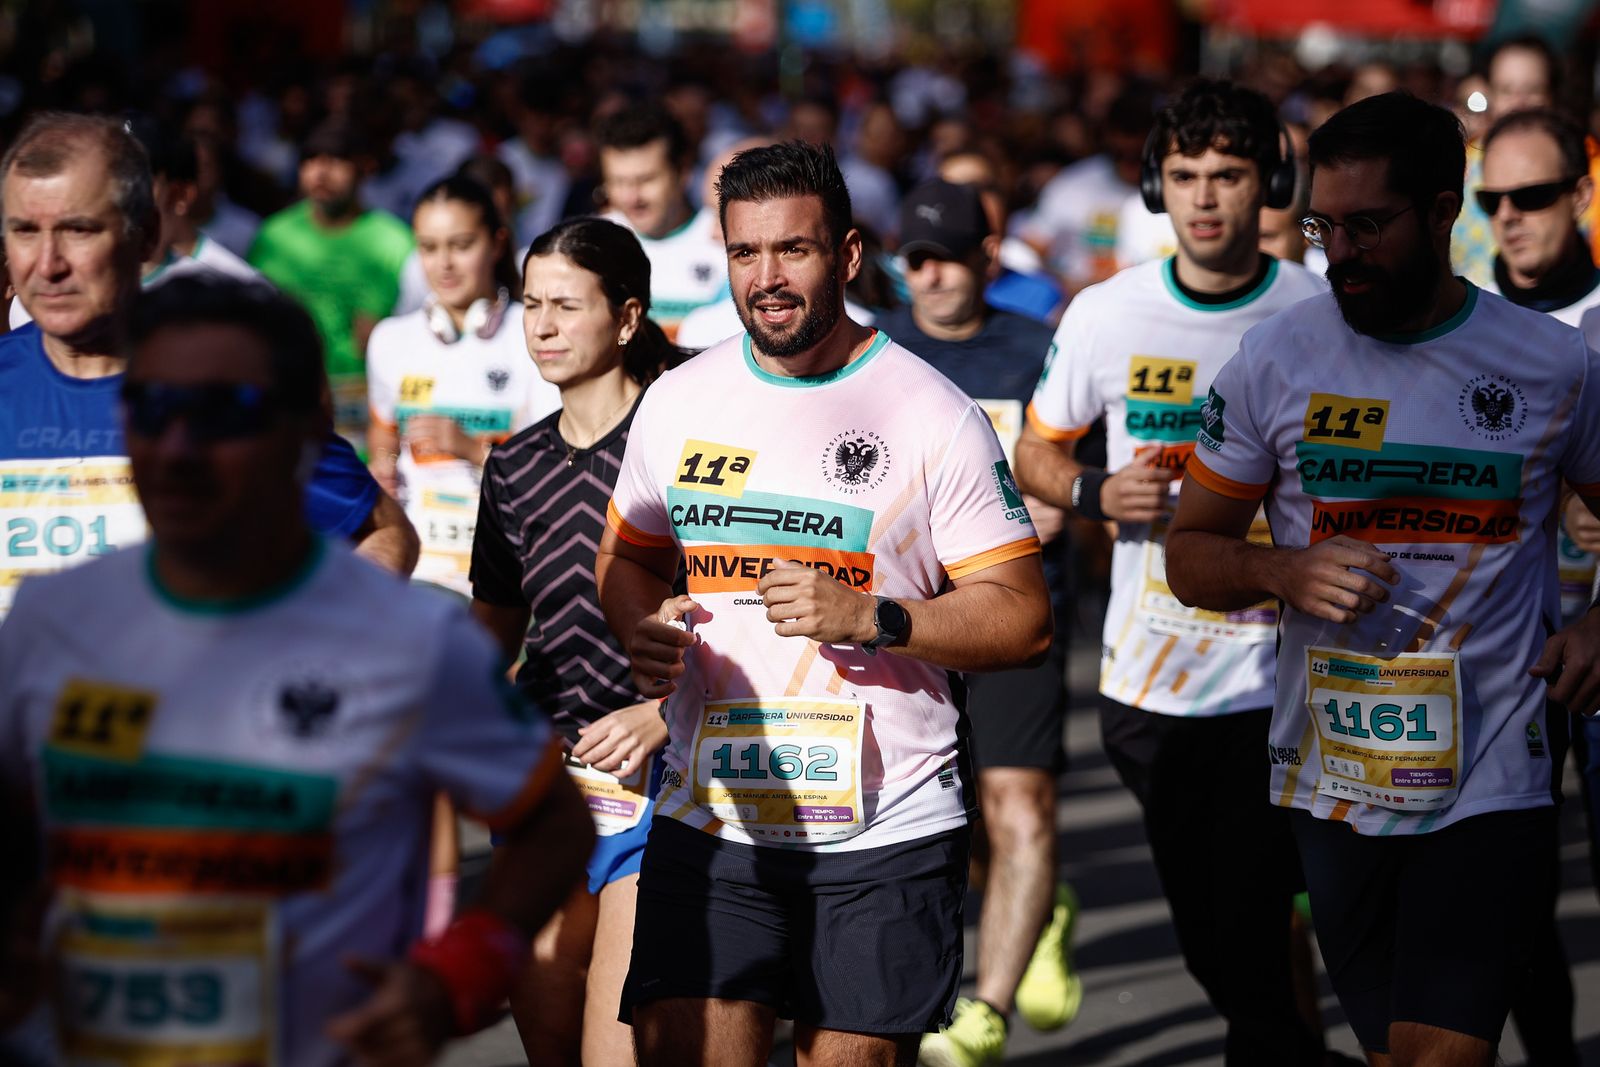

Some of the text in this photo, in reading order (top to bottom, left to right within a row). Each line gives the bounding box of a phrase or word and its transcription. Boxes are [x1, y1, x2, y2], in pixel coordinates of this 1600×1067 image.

[1131, 366, 1193, 394] 11ª
[1308, 406, 1385, 439] 11ª
[17, 427, 119, 449] CRAFT
[678, 452, 751, 486] 11ª
[1301, 458, 1499, 488] CARRERA
[670, 504, 844, 540] CARRERA
[1312, 507, 1520, 539] UNIVERSIDAD
[1413, 552, 1455, 562] GRANADA
[1312, 661, 1450, 678] 11ª CARRERA UNIVERSIDAD
[707, 712, 854, 726] 11ª CARRERA UNIVERSIDAD
[1324, 698, 1437, 742] 1161
[711, 743, 838, 781] 1162
[1277, 747, 1299, 759] RUN
